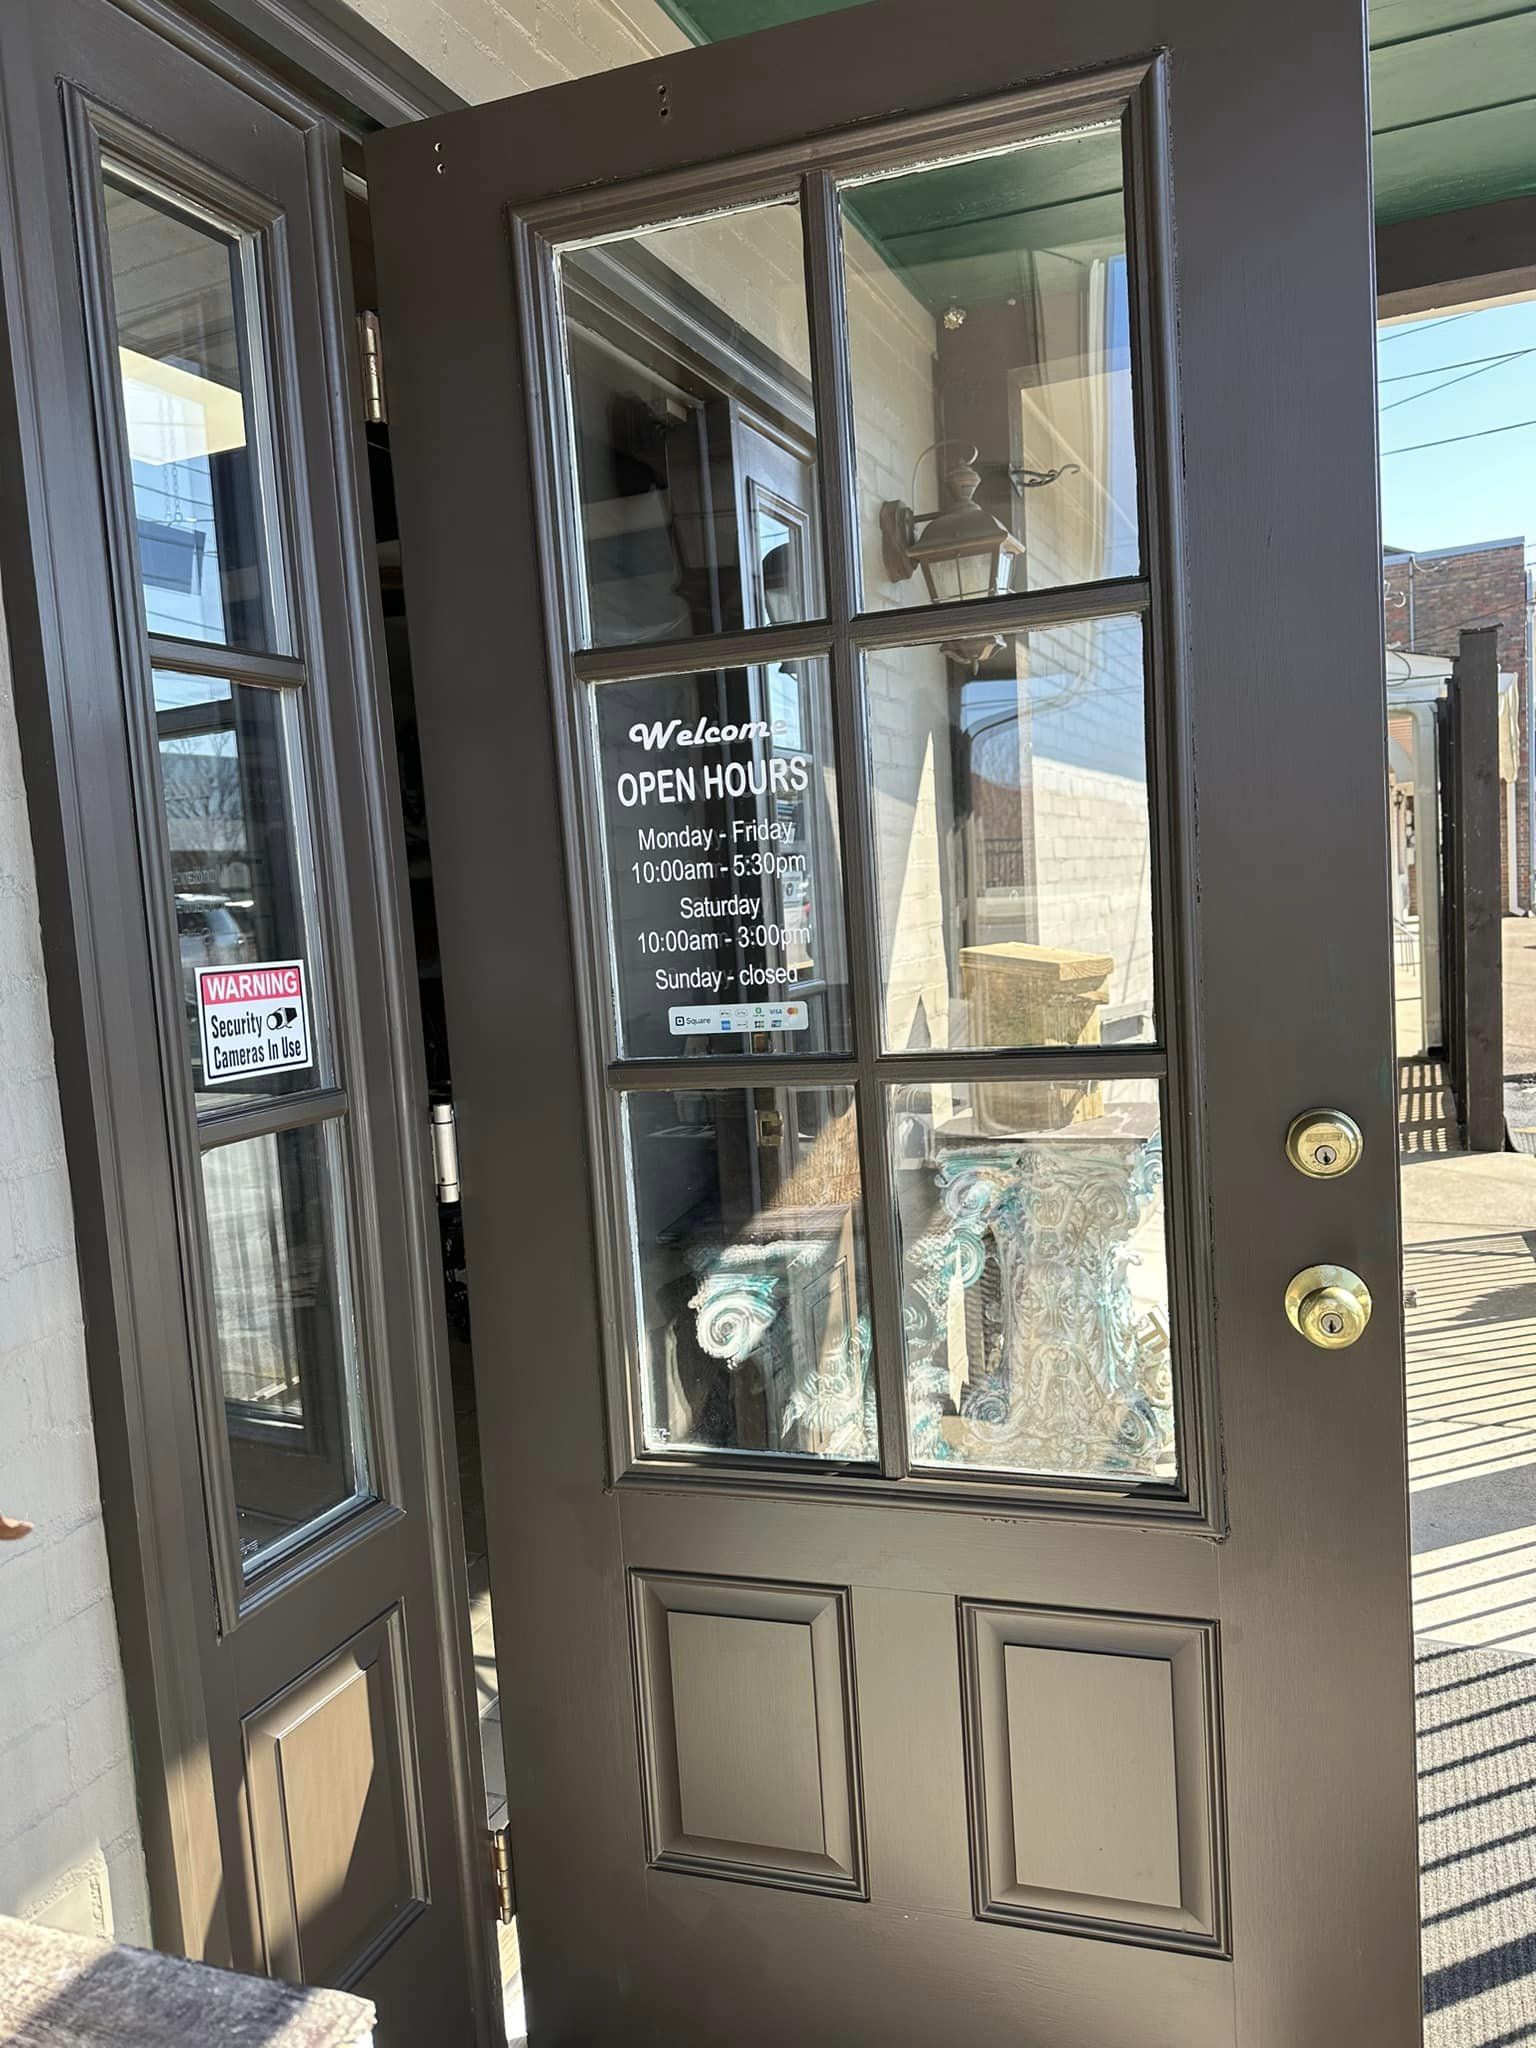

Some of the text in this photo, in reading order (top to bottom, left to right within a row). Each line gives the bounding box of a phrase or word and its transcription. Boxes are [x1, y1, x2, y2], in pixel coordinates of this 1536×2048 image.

[629, 716, 787, 750] Welcome
[617, 756, 809, 807] OPEN HOURS
[638, 825, 714, 851] Monday
[732, 818, 793, 843] Friday
[631, 859, 714, 884] 10:00am
[733, 852, 807, 879] 5:30pm
[680, 895, 760, 920] Saturday
[637, 929, 719, 954] 10:00am
[738, 924, 811, 951] 3:00pm
[207, 971, 298, 1000] WARNING
[655, 966, 722, 992] Sunday
[739, 963, 798, 986] closed
[211, 1011, 262, 1039] Security
[685, 1016, 712, 1026] Square
[213, 1036, 302, 1070] Cameras In Use
